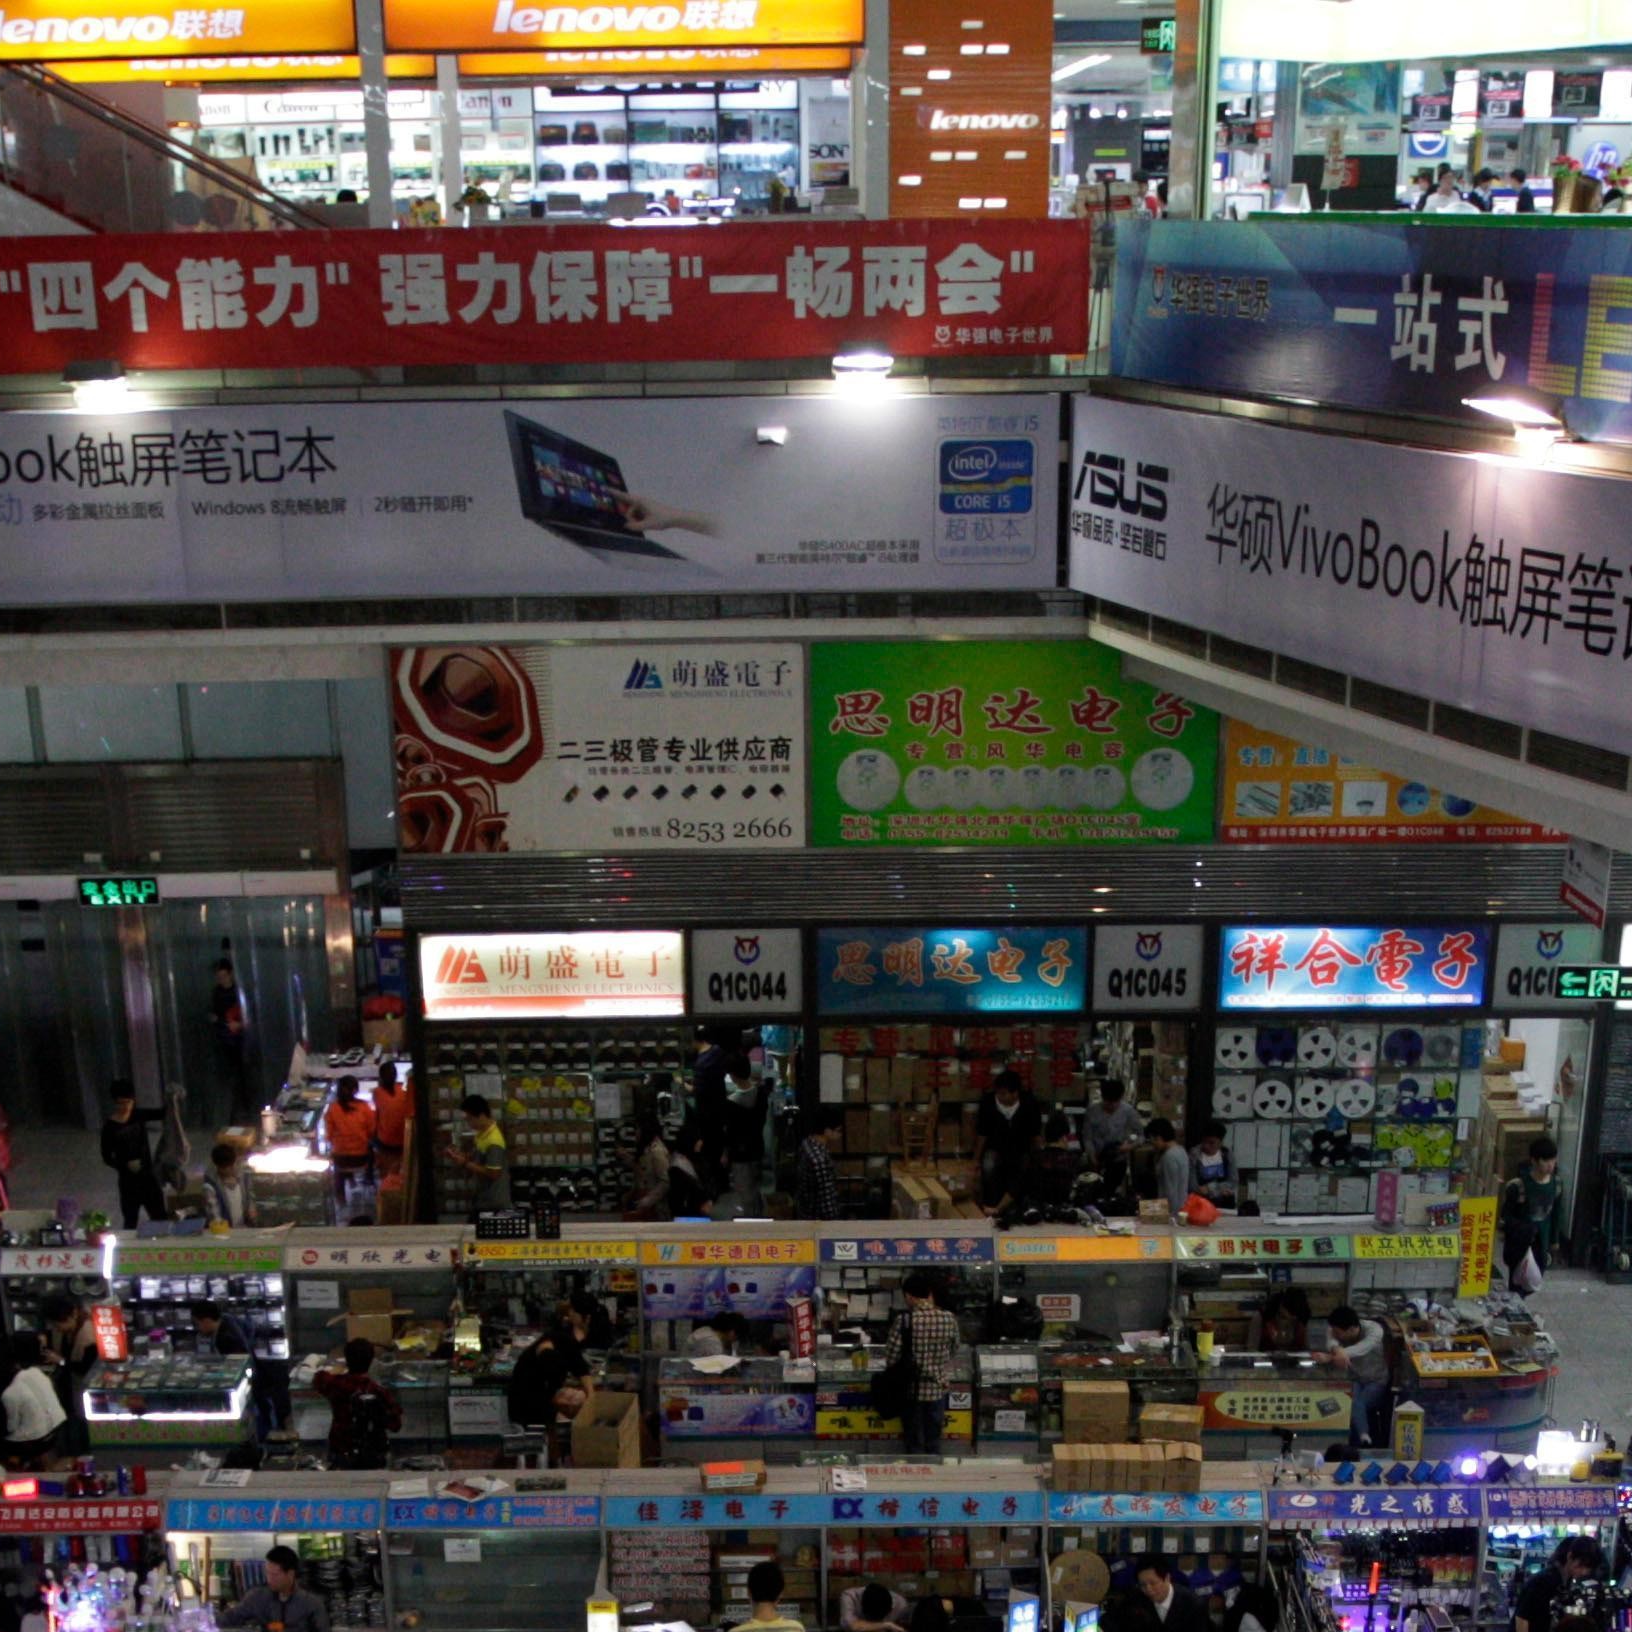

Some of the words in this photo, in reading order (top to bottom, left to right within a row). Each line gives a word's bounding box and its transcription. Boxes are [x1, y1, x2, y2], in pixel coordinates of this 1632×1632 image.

[171, 8, 244, 38] 联想
[494, 0, 677, 36] lenovo
[681, 0, 756, 30] 联想
[929, 107, 1039, 132] lenovo
[1170, 270, 1271, 321] 华强电子世界
[954, 322, 1054, 347] 华强电子世界
[953, 453, 994, 473] intel
[1073, 450, 1170, 522] ASUS
[30, 501, 166, 522] 多彩金属拉丝面板
[191, 499, 266, 518] Windows
[953, 495, 991, 509] CORE
[944, 518, 1021, 542] 超极本
[672, 659, 792, 688] 萌盛電子
[829, 686, 1196, 738] 思明达电子
[556, 735, 793, 763] 二三极管专业供应商
[905, 742, 1127, 761] 专营:风华电容
[666, 817, 724, 843] 8253
[733, 817, 792, 839] 2666
[81, 878, 156, 896] 安全出口
[90, 893, 149, 905] EXIT
[498, 945, 673, 981] 萌盛電子
[831, 935, 1074, 987] 思明达电子
[1229, 927, 1478, 992] 祥合電子
[709, 971, 787, 1003] Q1C044
[1108, 967, 1187, 999] Q1C045
[637, 1499, 790, 1522] 佳泽电子
[1348, 1493, 1469, 1517] 光之诱惑
